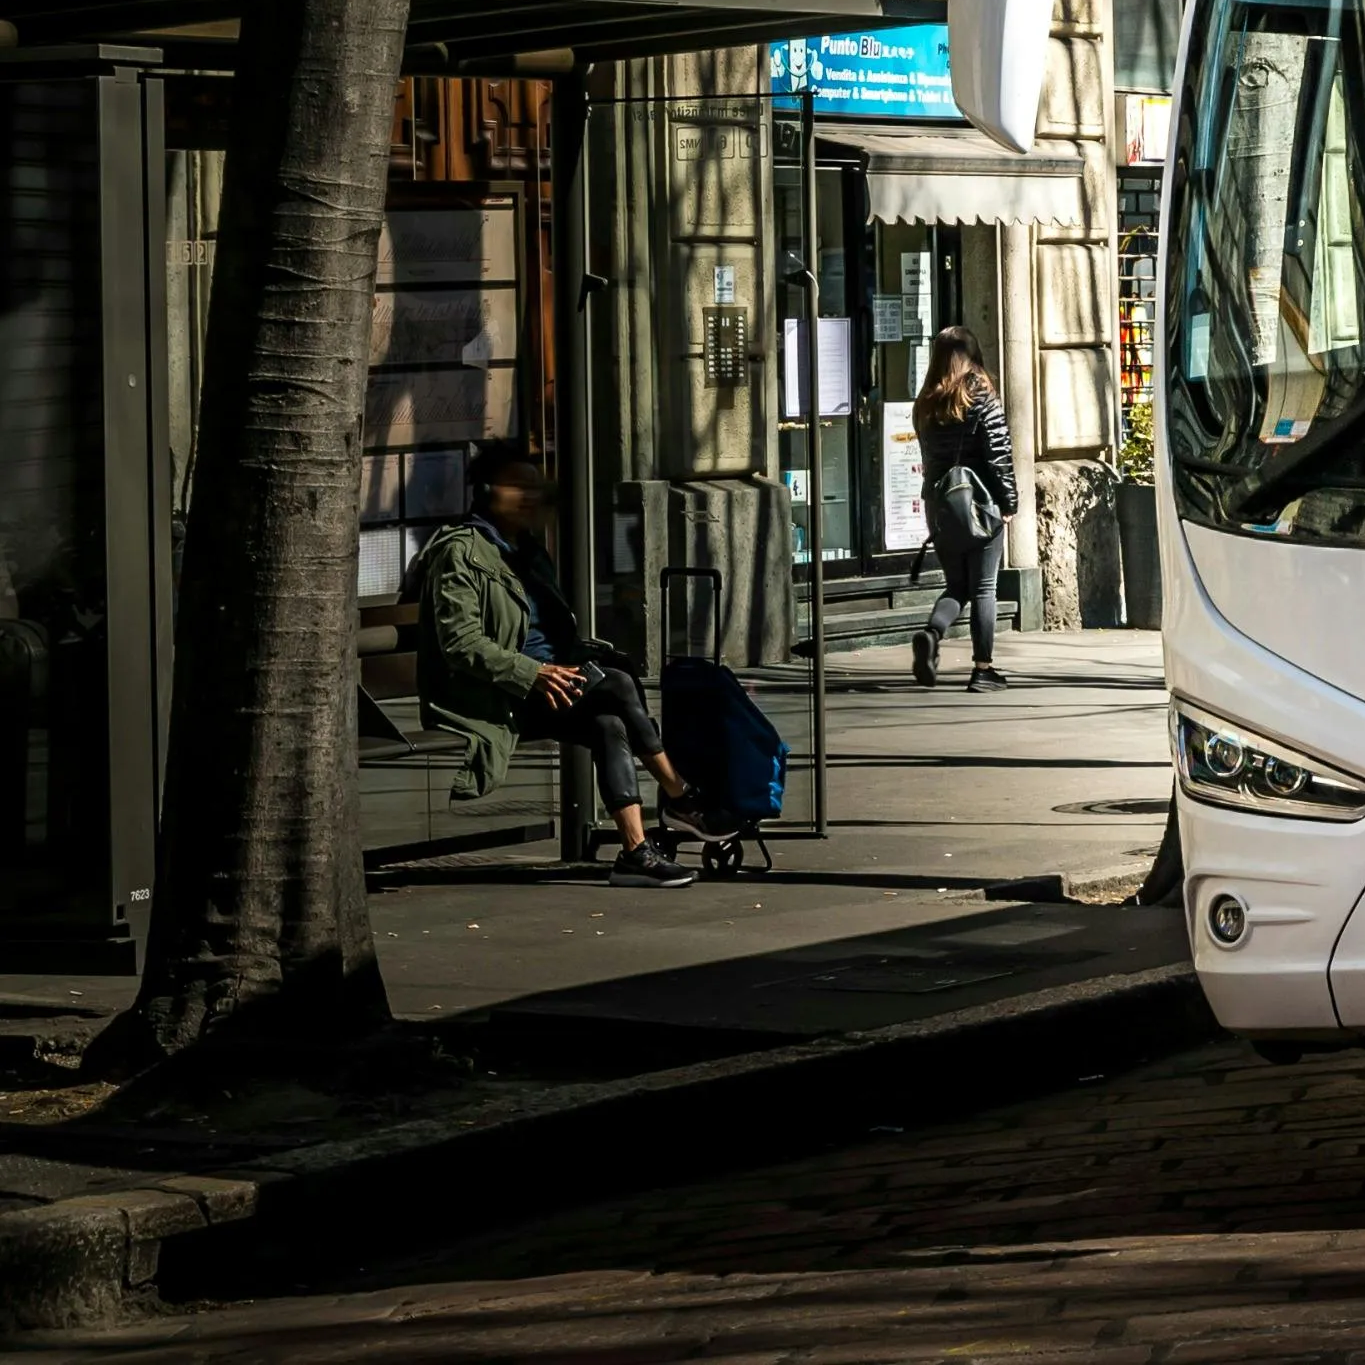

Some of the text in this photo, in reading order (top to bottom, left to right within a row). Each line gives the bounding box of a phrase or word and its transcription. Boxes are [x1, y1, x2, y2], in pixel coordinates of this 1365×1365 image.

[821, 35, 857, 56] Punto
[860, 37, 881, 57] Blu
[130, 888, 150, 902] 7623
